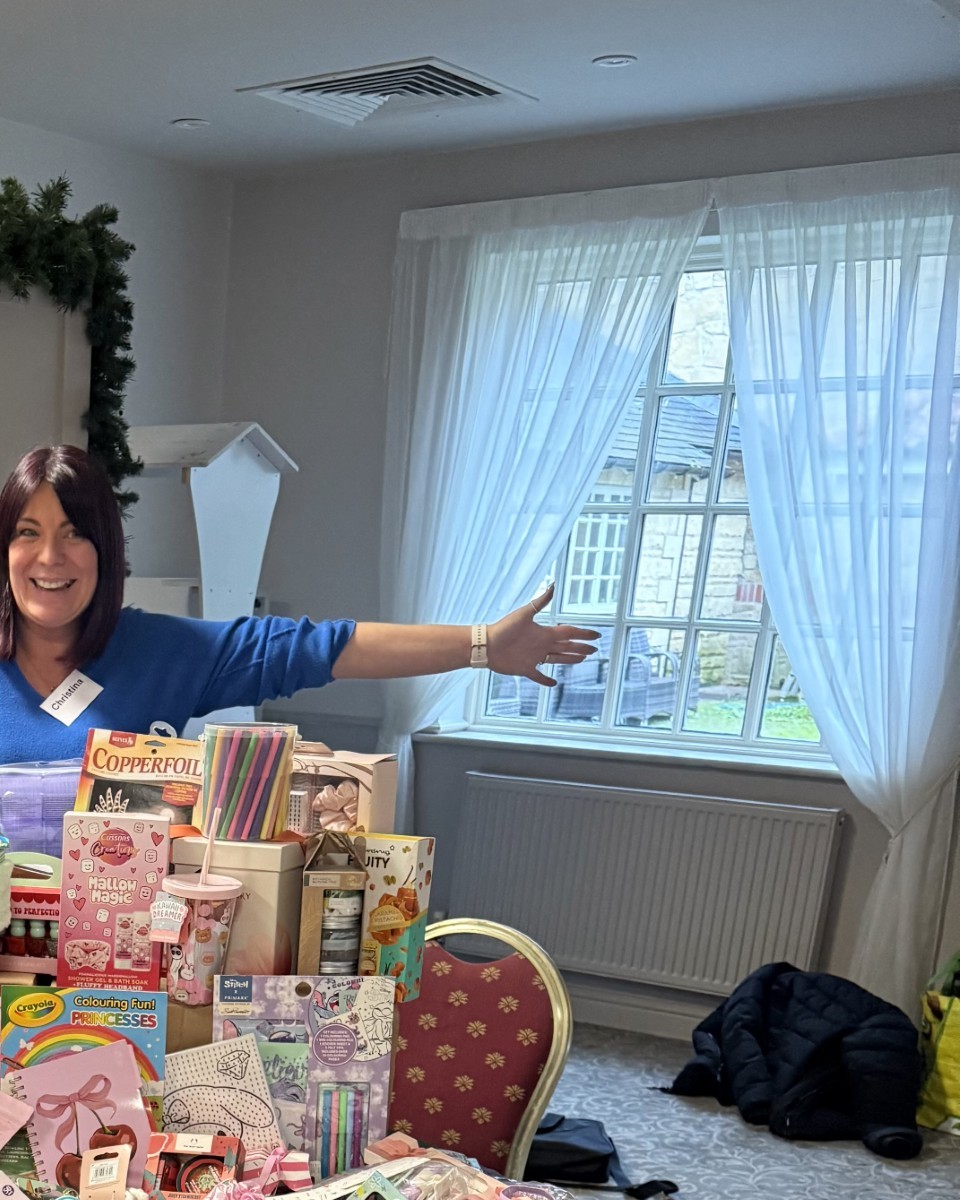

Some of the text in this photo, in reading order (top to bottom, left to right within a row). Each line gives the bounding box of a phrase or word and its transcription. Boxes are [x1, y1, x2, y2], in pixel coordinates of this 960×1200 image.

[51, 678, 84, 711] Christina
[92, 748, 203, 777] COPPERFOIL
[152, 911, 183, 921] DREAMER
[15, 998, 56, 1019] Crayola
[74, 995, 156, 1011] Colouring Fun!
[71, 1011, 158, 1030] PRINCESSES
